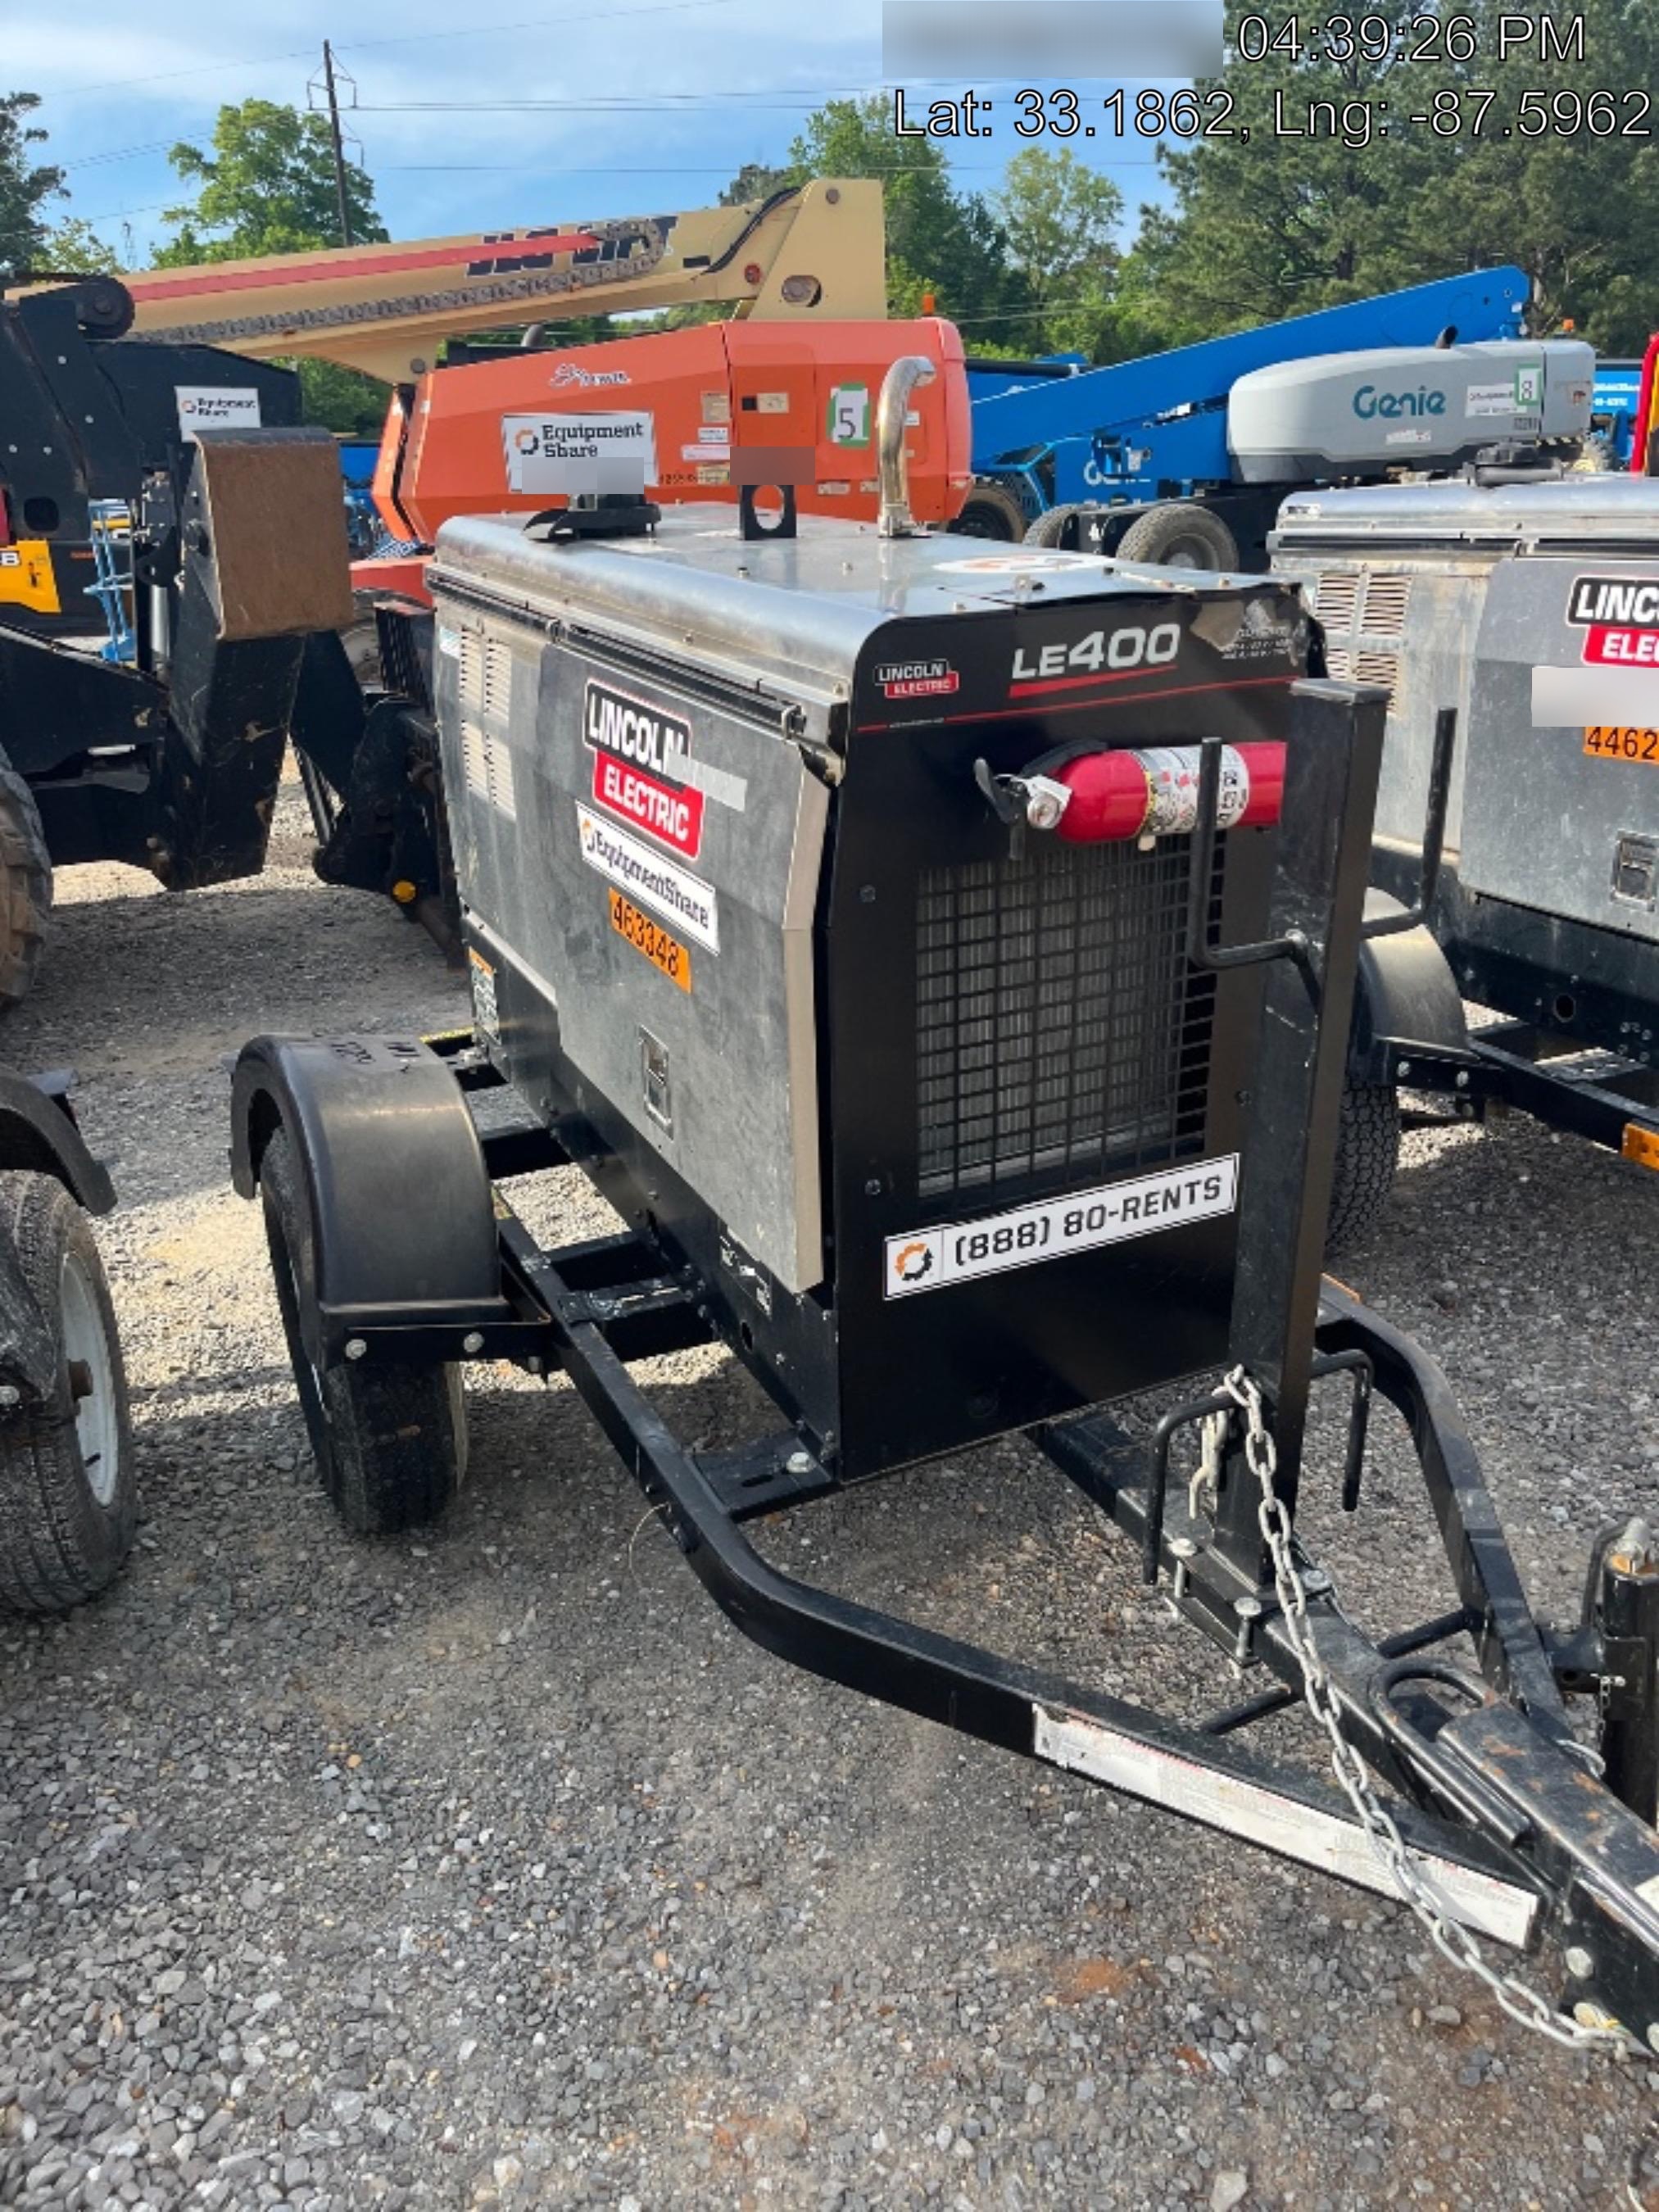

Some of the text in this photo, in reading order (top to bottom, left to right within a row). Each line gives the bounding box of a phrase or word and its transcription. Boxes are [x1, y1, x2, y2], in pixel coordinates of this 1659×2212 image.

[1353, 385, 1447, 420] Genie
[542, 422, 644, 443] Equipment
[837, 408, 857, 438] 5
[544, 442, 598, 457] Share
[1010, 623, 1181, 679] LE400
[878, 662, 945, 682] LINCOLN
[893, 678, 952, 696] ELECTRIC
[603, 764, 690, 841] ELECTRIC
[596, 830, 709, 930] EquipmentShare
[613, 895, 679, 977] 463348
[954, 1176, 1222, 1266] (888) 80-RENTS
